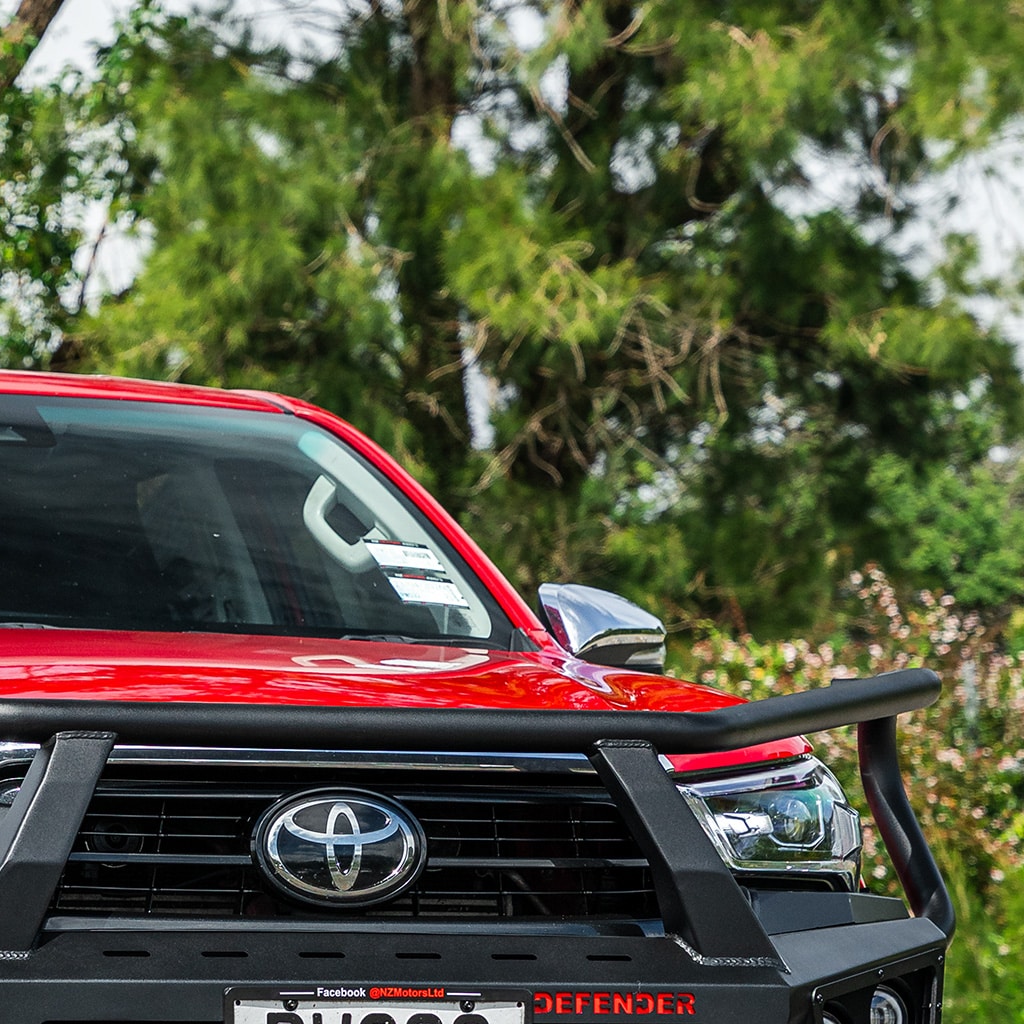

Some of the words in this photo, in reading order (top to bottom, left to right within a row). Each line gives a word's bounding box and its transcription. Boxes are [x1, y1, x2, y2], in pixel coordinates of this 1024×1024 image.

[317, 987, 366, 998] Facebook
[369, 987, 444, 999] @NZMotorsLtd
[533, 992, 696, 1015] DEFENDER
